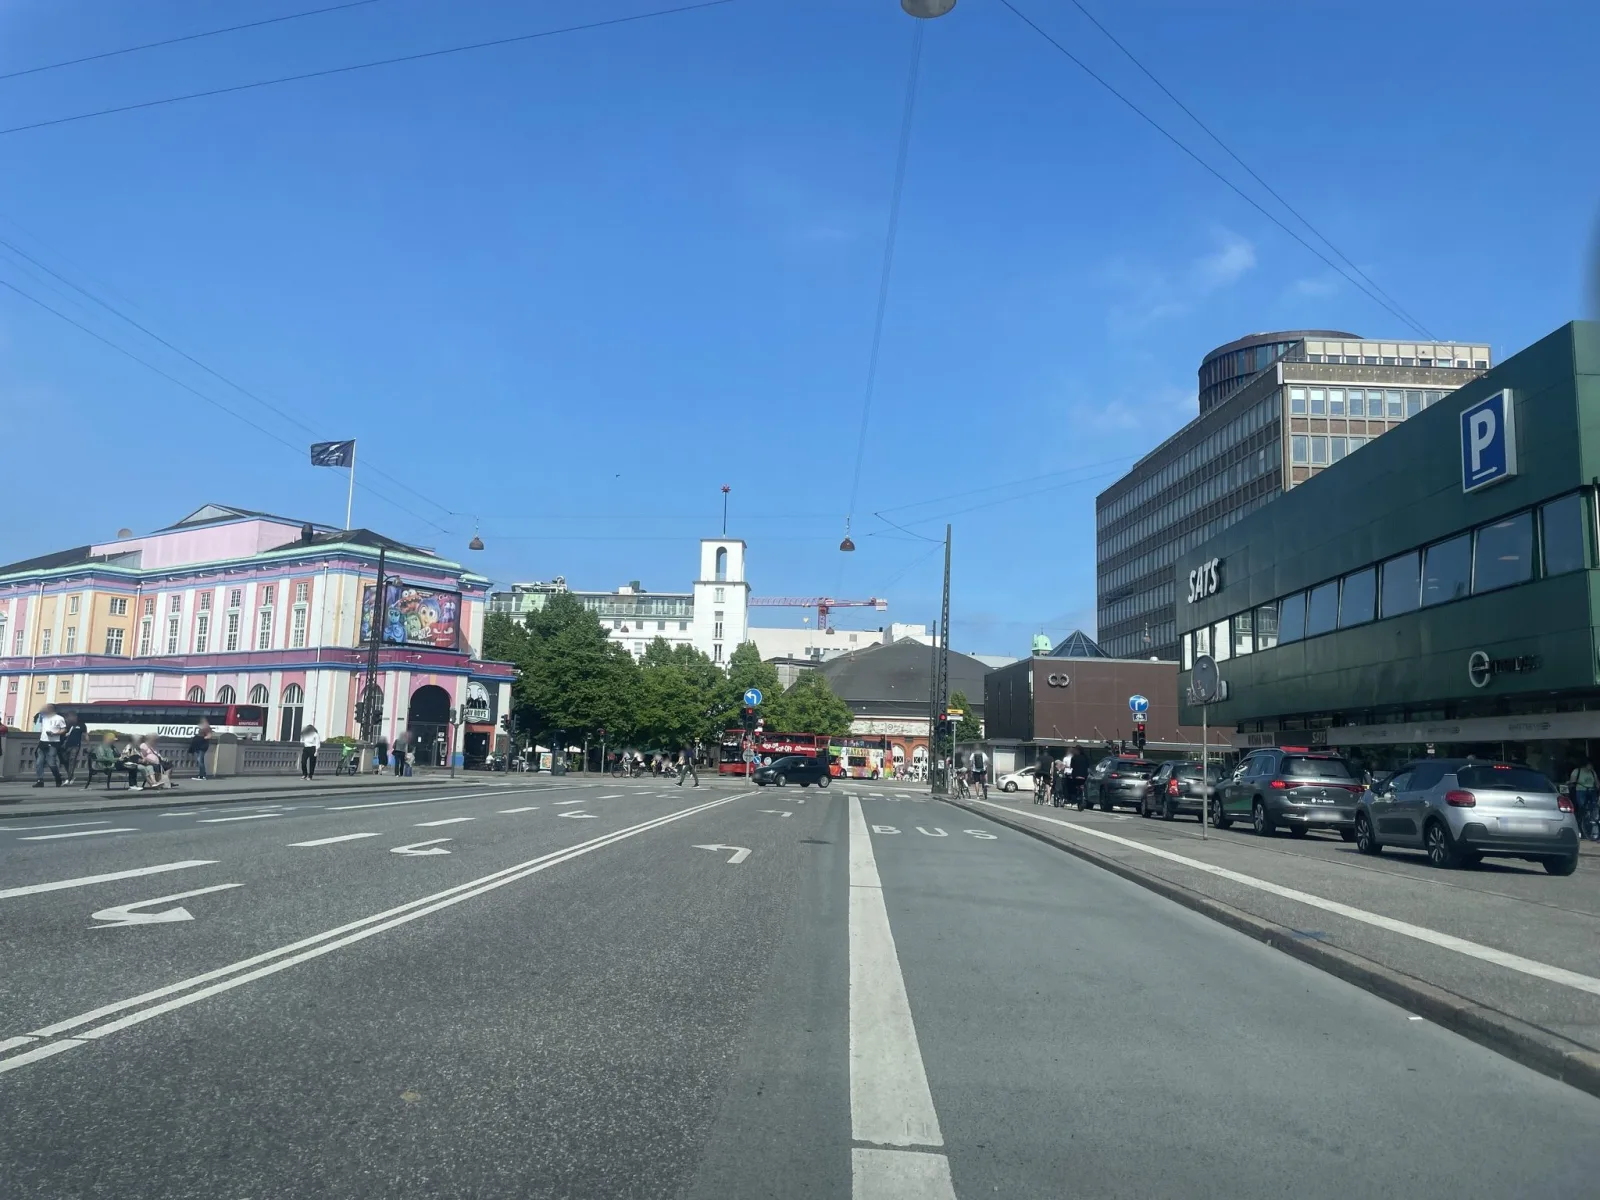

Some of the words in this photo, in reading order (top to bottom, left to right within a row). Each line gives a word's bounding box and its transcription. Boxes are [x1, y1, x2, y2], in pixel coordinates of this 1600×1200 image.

[1470, 408, 1496, 473] P
[1188, 557, 1219, 604] SATS
[872, 825, 998, 840] BUS
